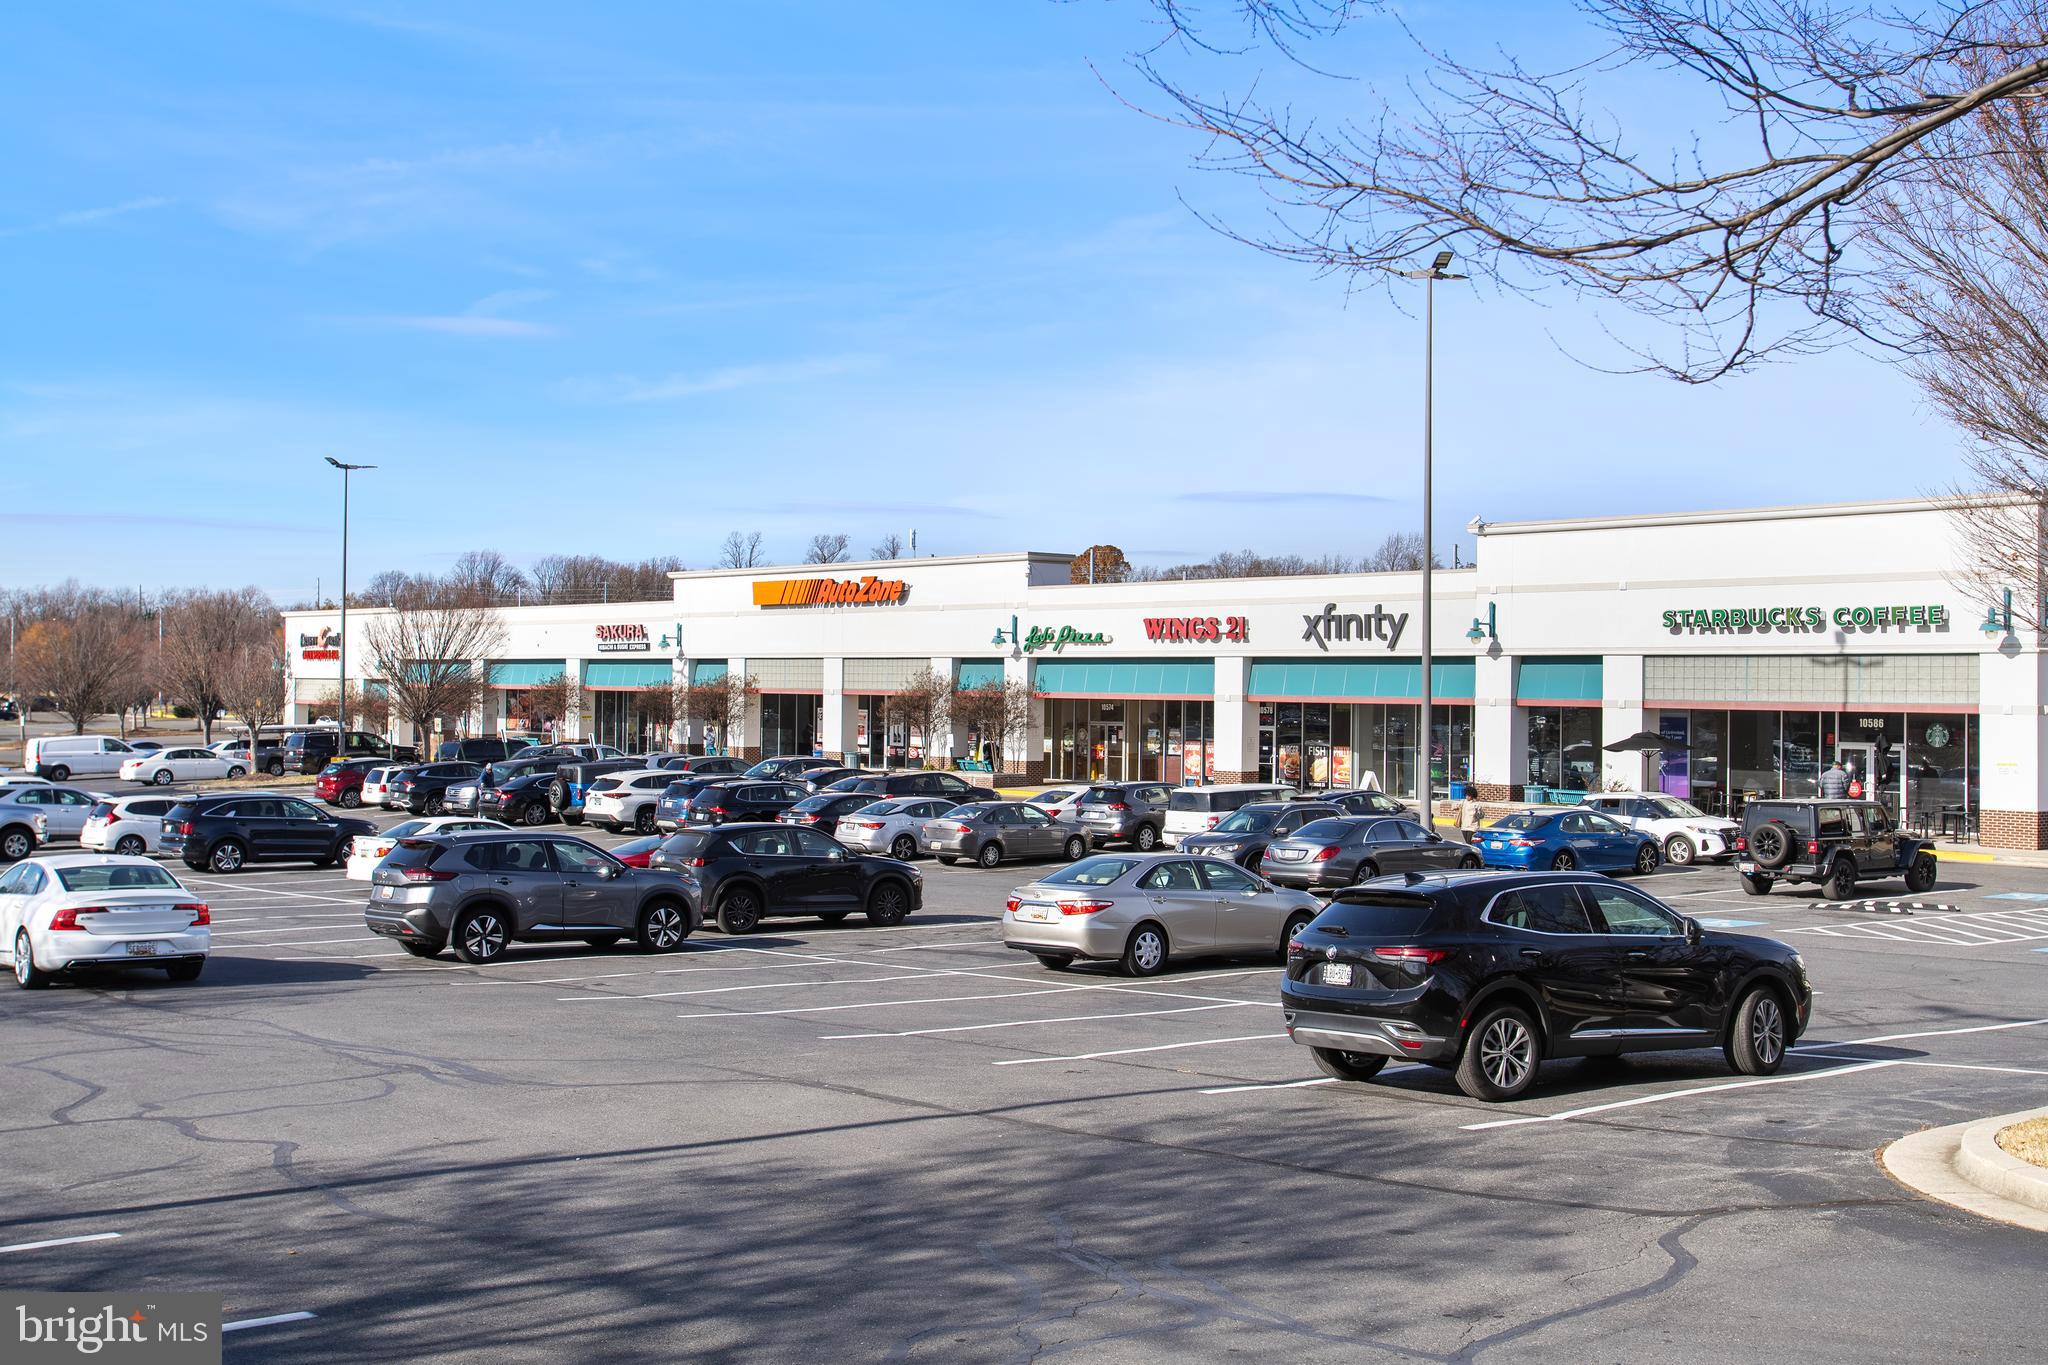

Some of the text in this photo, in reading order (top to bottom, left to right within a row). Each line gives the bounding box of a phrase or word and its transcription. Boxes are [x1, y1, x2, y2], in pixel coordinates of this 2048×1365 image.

[817, 576, 904, 603] AutoZone
[1144, 616, 1246, 640] WINGS 21
[1302, 603, 1409, 651] xfinity
[1663, 604, 1945, 629] STARBUCKS COFFEE
[596, 624, 644, 638] SAKURA
[1053, 625, 1104, 651] Pizza
[1859, 718, 1884, 728] 10586
[1308, 746, 1326, 756] FISH
